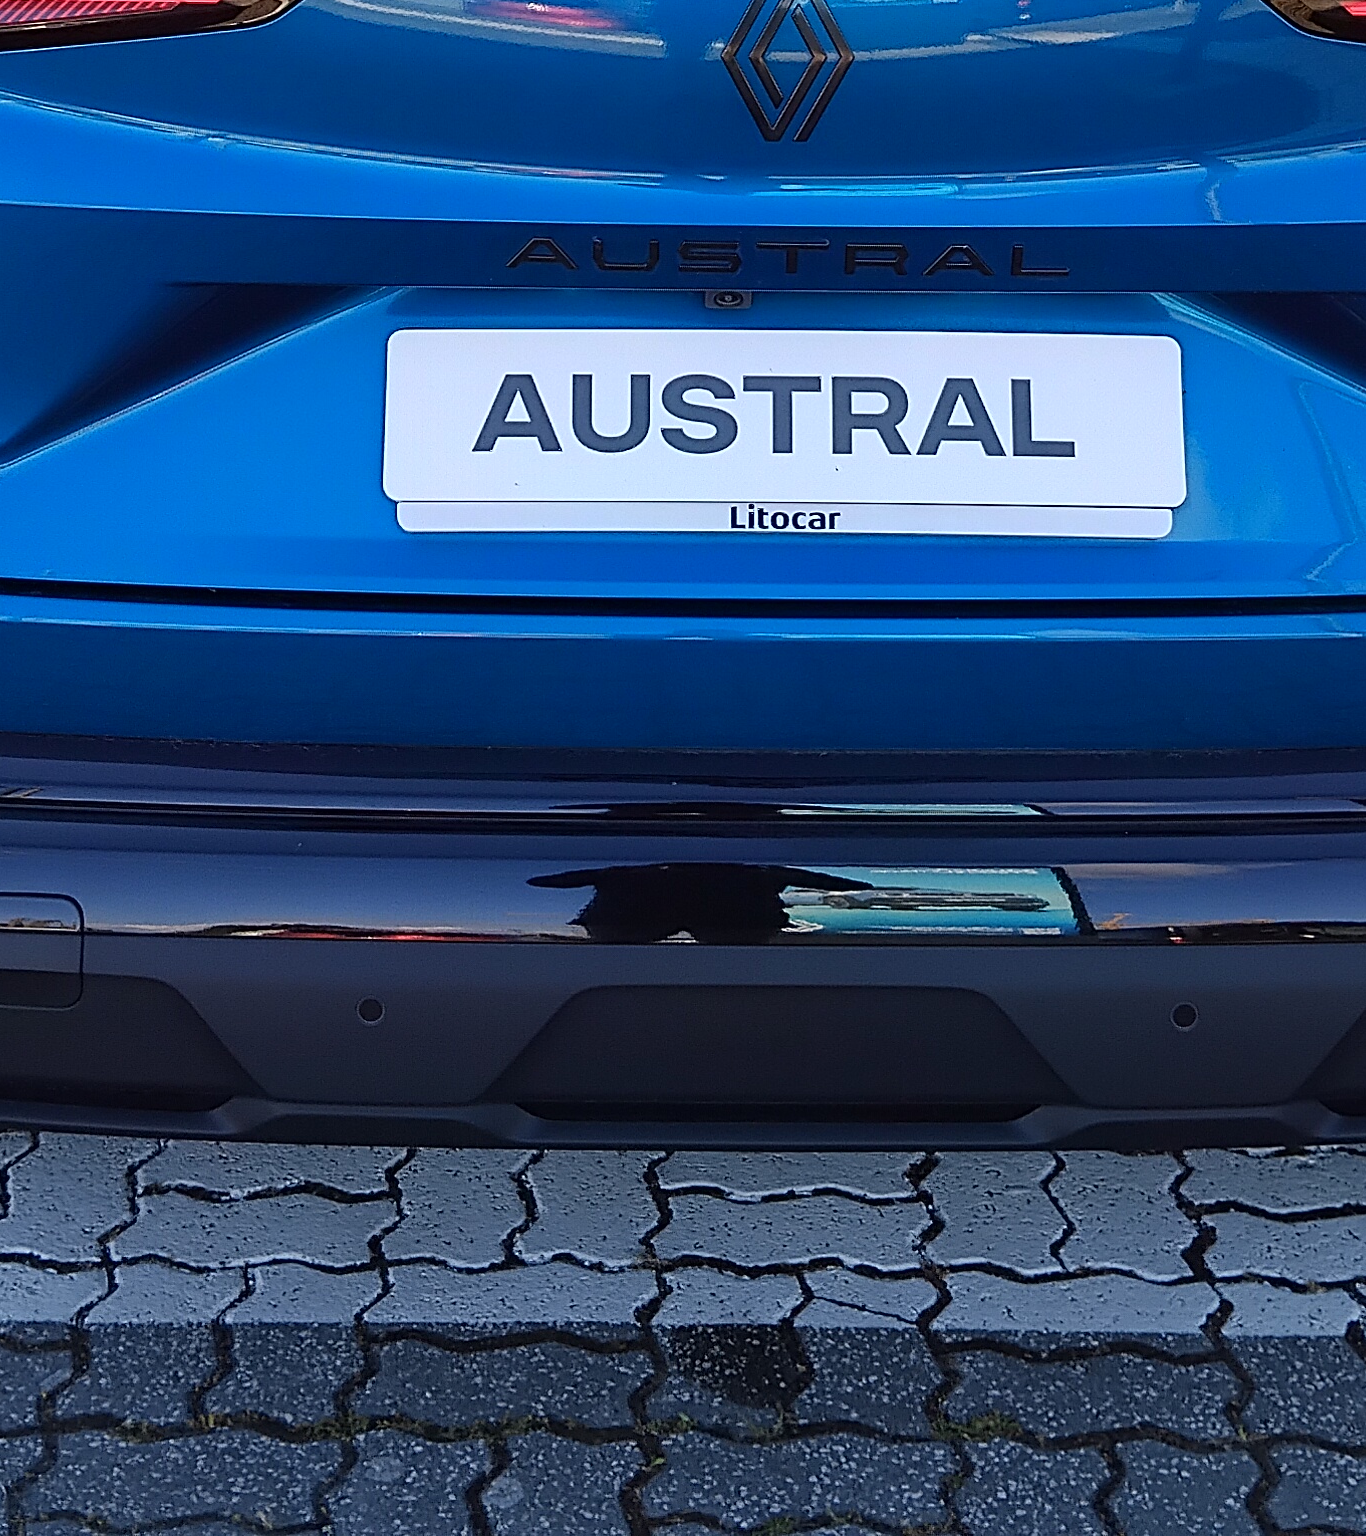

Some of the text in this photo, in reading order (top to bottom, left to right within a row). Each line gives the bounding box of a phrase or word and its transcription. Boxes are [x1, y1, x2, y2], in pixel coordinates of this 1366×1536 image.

[506, 236, 1071, 278] AUSTRAL
[471, 373, 1077, 458] AUSTRAL
[730, 503, 841, 530] Litocar
